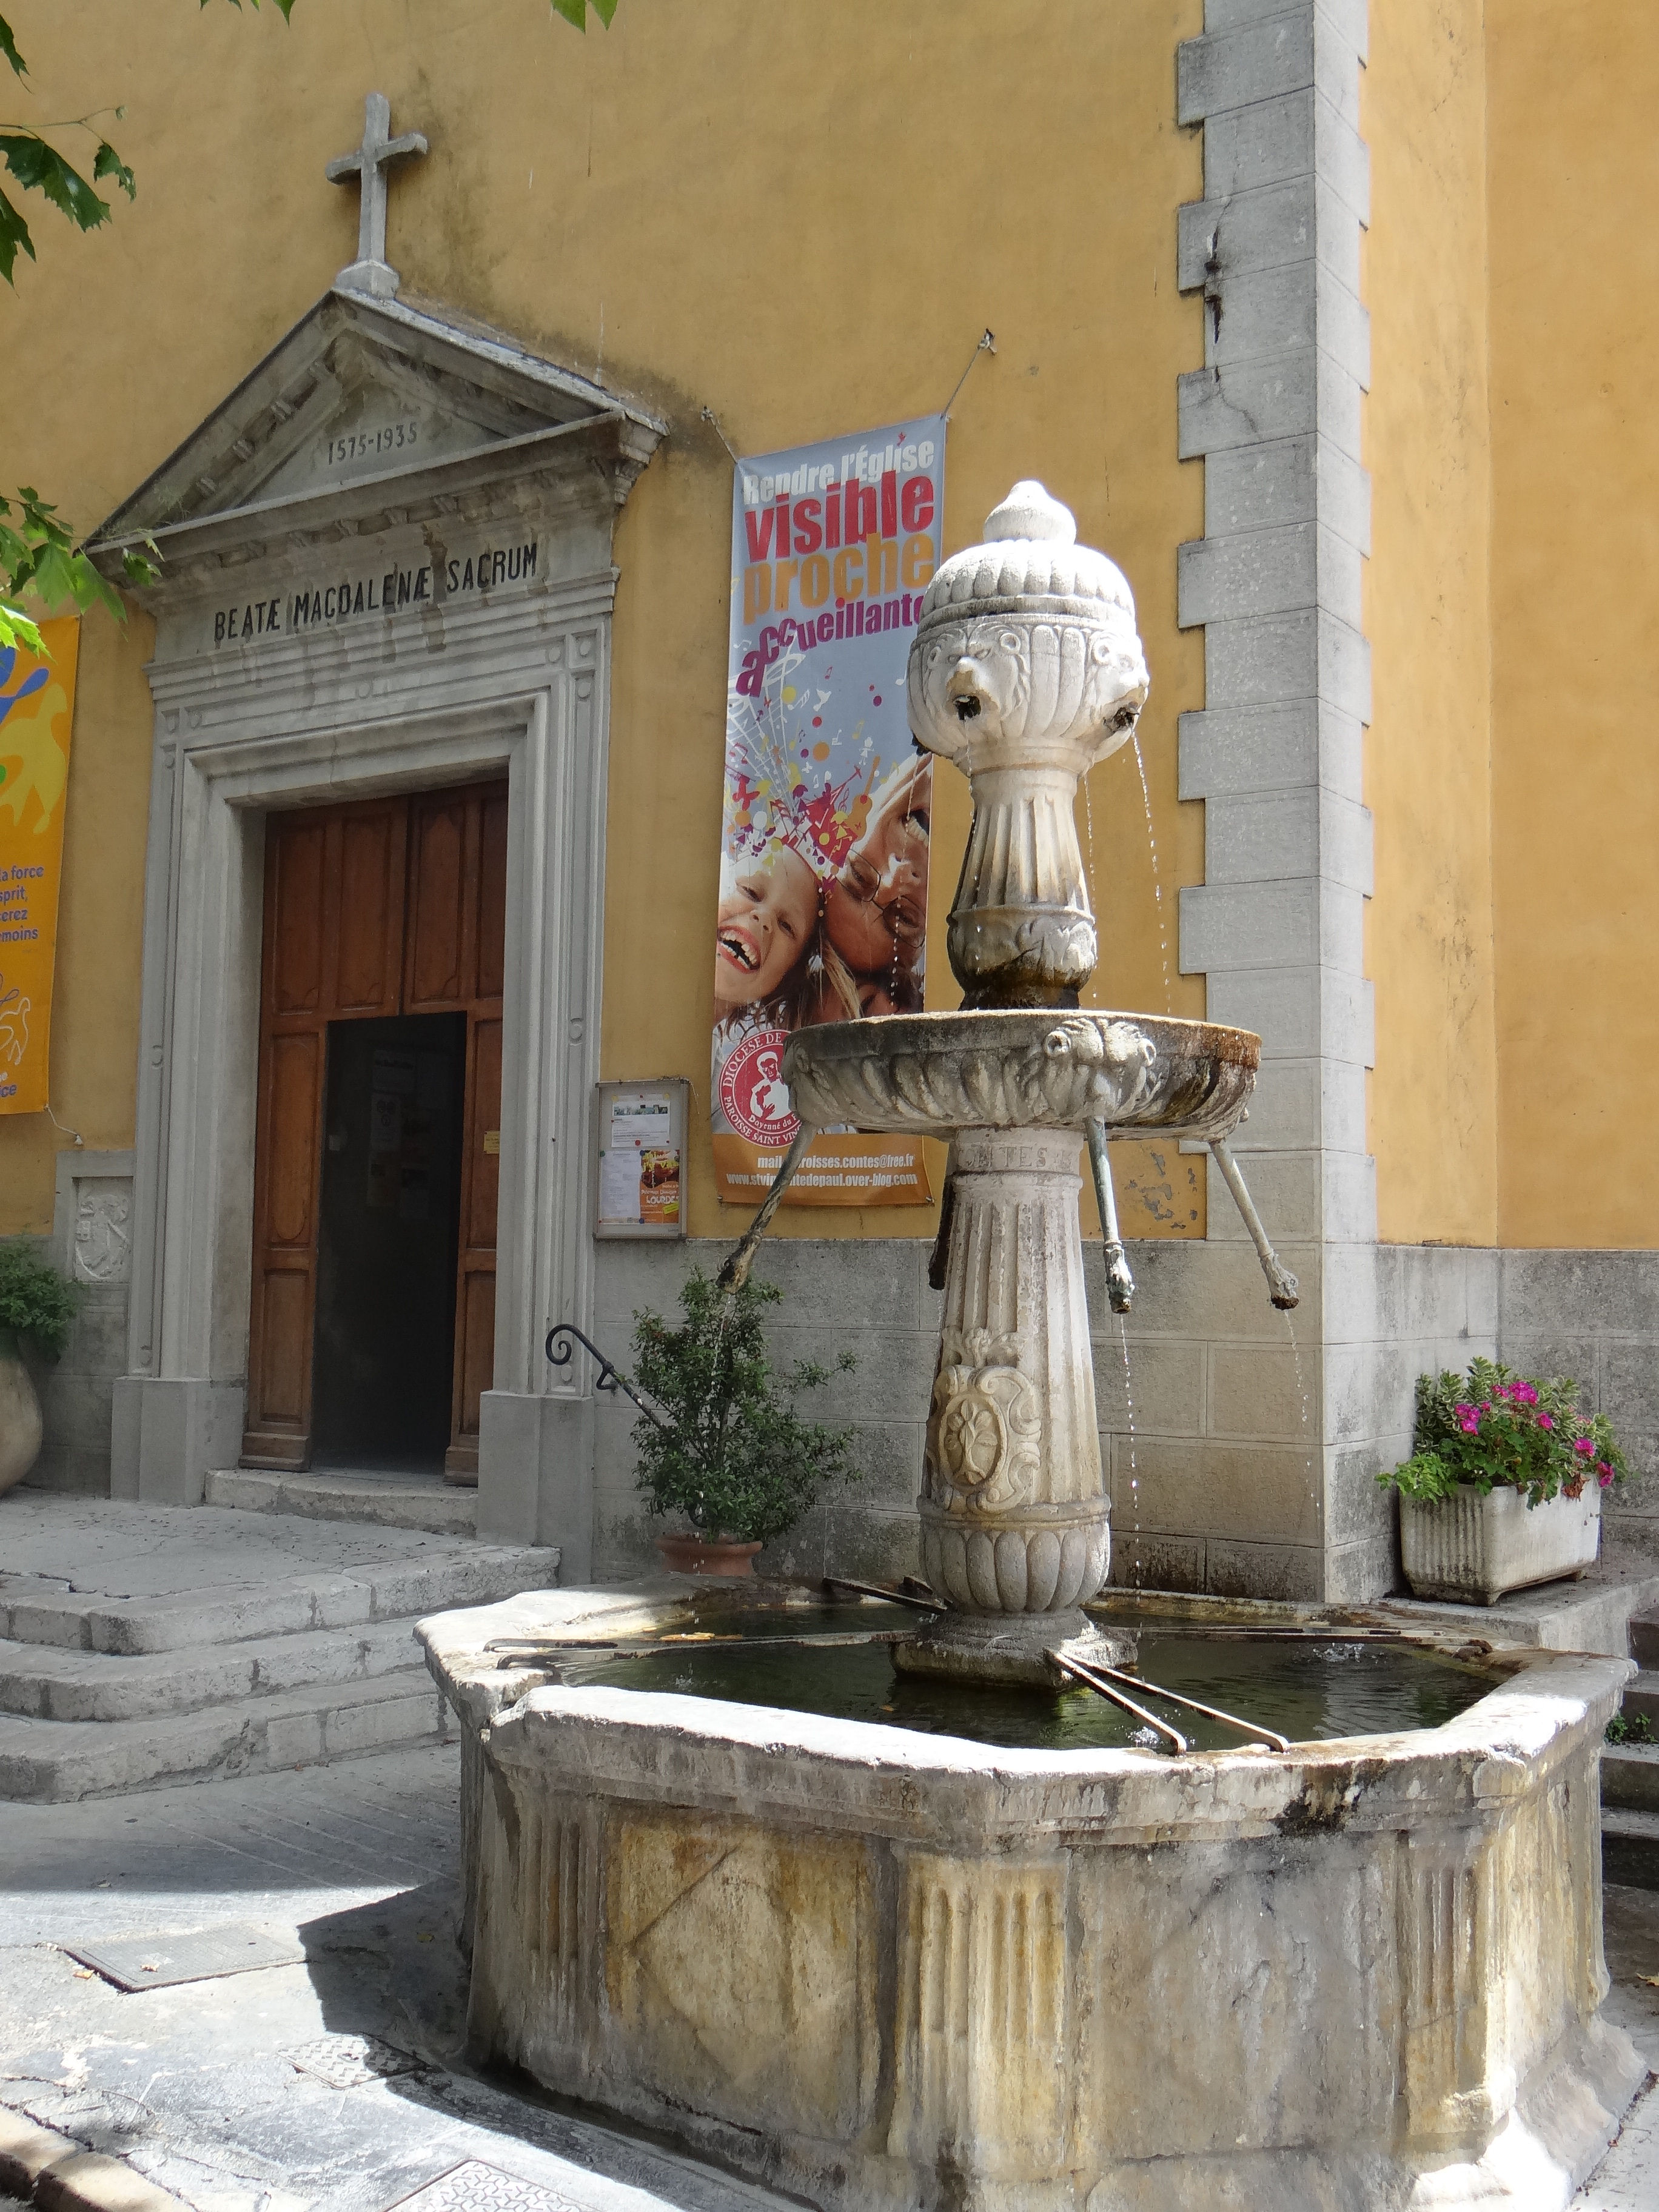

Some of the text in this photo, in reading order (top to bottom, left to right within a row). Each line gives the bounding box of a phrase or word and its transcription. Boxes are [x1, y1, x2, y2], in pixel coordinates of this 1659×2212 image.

[328, 421, 417, 465] 1575-1935
[742, 440, 934, 504] Rendre l'Église
[745, 470, 934, 563] visible
[447, 543, 538, 594] SACRUM
[743, 531, 934, 626] proche
[0, 865, 44, 881] a force
[0, 910, 27, 922] erez
[0, 925, 38, 942] moins
[723, 1032, 782, 1087] DIOCESE DE
[723, 1096, 752, 1137] PAROISSE
[752, 1133, 781, 1145] SAINT
[748, 1114, 780, 1130] Doyenné
[798, 1153, 914, 1169] roisses.contes@free.fr
